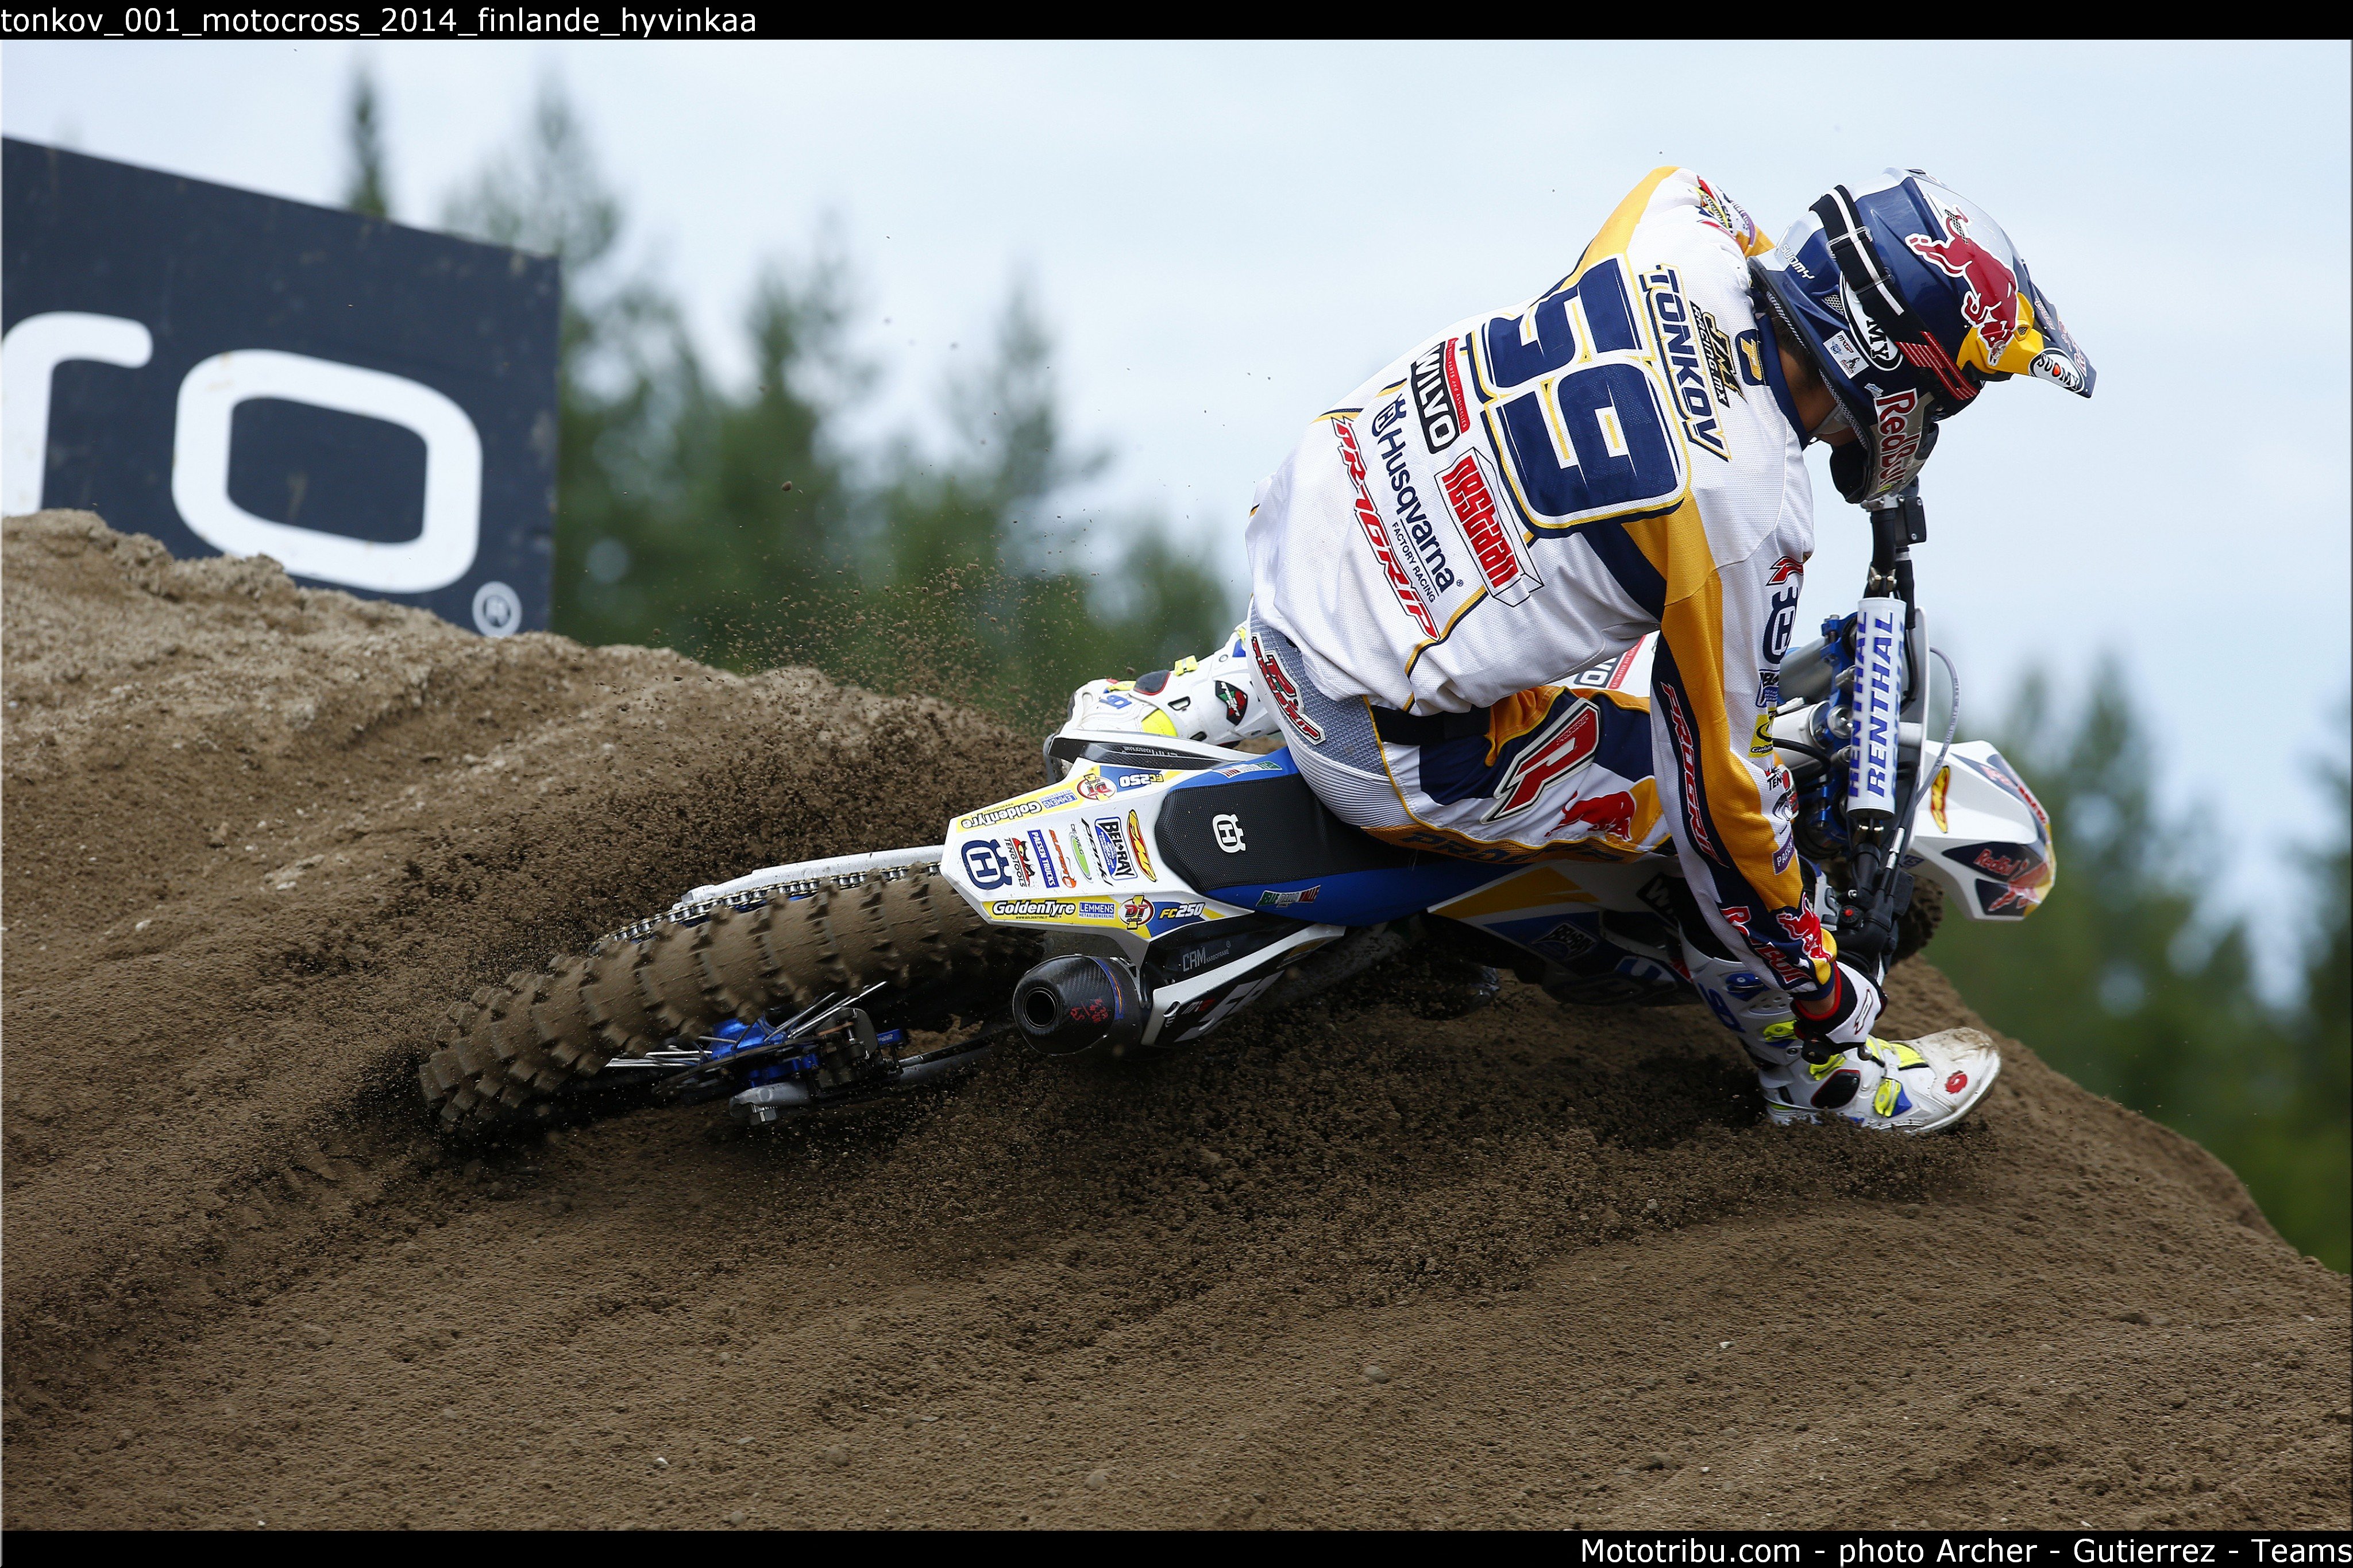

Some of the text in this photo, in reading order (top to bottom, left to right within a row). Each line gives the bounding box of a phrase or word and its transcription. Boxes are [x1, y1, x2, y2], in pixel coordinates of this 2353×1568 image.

[1780, 244, 1815, 280] SUOMY
[1646, 265, 1725, 458] TONKOV
[2036, 354, 2080, 392] SUOMY
[1415, 341, 1457, 451] WILVO
[1487, 257, 1679, 517] 59
[1378, 428, 1454, 592] Husqvarna
[1391, 522, 1435, 603] FACTORY RACING
[1868, 612, 1893, 797] RENTHAL
[1119, 773, 1164, 787] FC250
[961, 801, 1042, 829] GoldenTyre
[1045, 791, 1077, 809] LEMMENS
[1031, 832, 1056, 886] PAESEN TRUCKS
[992, 900, 1075, 918] GoldenTyre
[1079, 903, 1114, 913] LEMMENS
[1159, 902, 1205, 920] FC250
